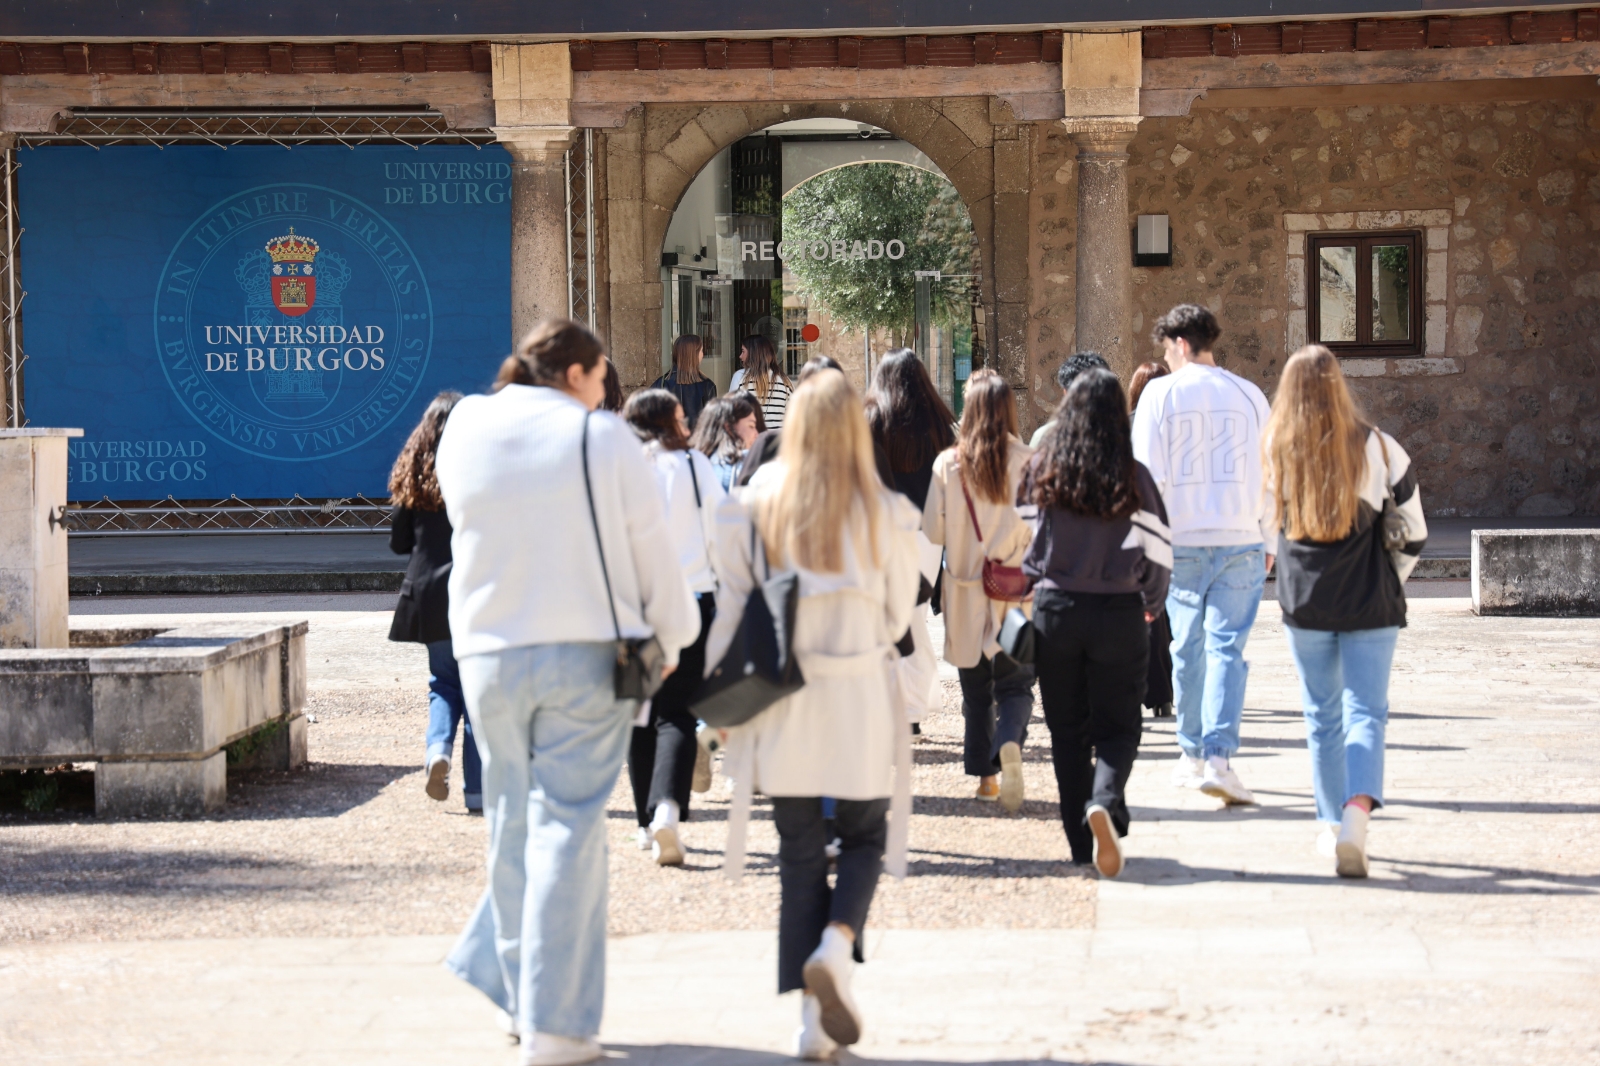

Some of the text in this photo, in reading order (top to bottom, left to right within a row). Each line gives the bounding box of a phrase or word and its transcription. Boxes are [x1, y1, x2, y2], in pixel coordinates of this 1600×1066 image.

[383, 162, 512, 180] UNIVERSID
[384, 182, 512, 205] DE BURG
[167, 191, 418, 297] IN ITINERE VERITAS
[741, 239, 906, 262] RECTORADO
[204, 325, 385, 345] UNIVERSIDAD
[205, 347, 385, 372] DE BURGOS
[164, 337, 424, 452] BVRGENSIS VNIVERSITAS
[67, 440, 207, 459] NIVERSIDAD
[1166, 410, 1249, 487] 22
[79, 460, 207, 483] BURGOS
